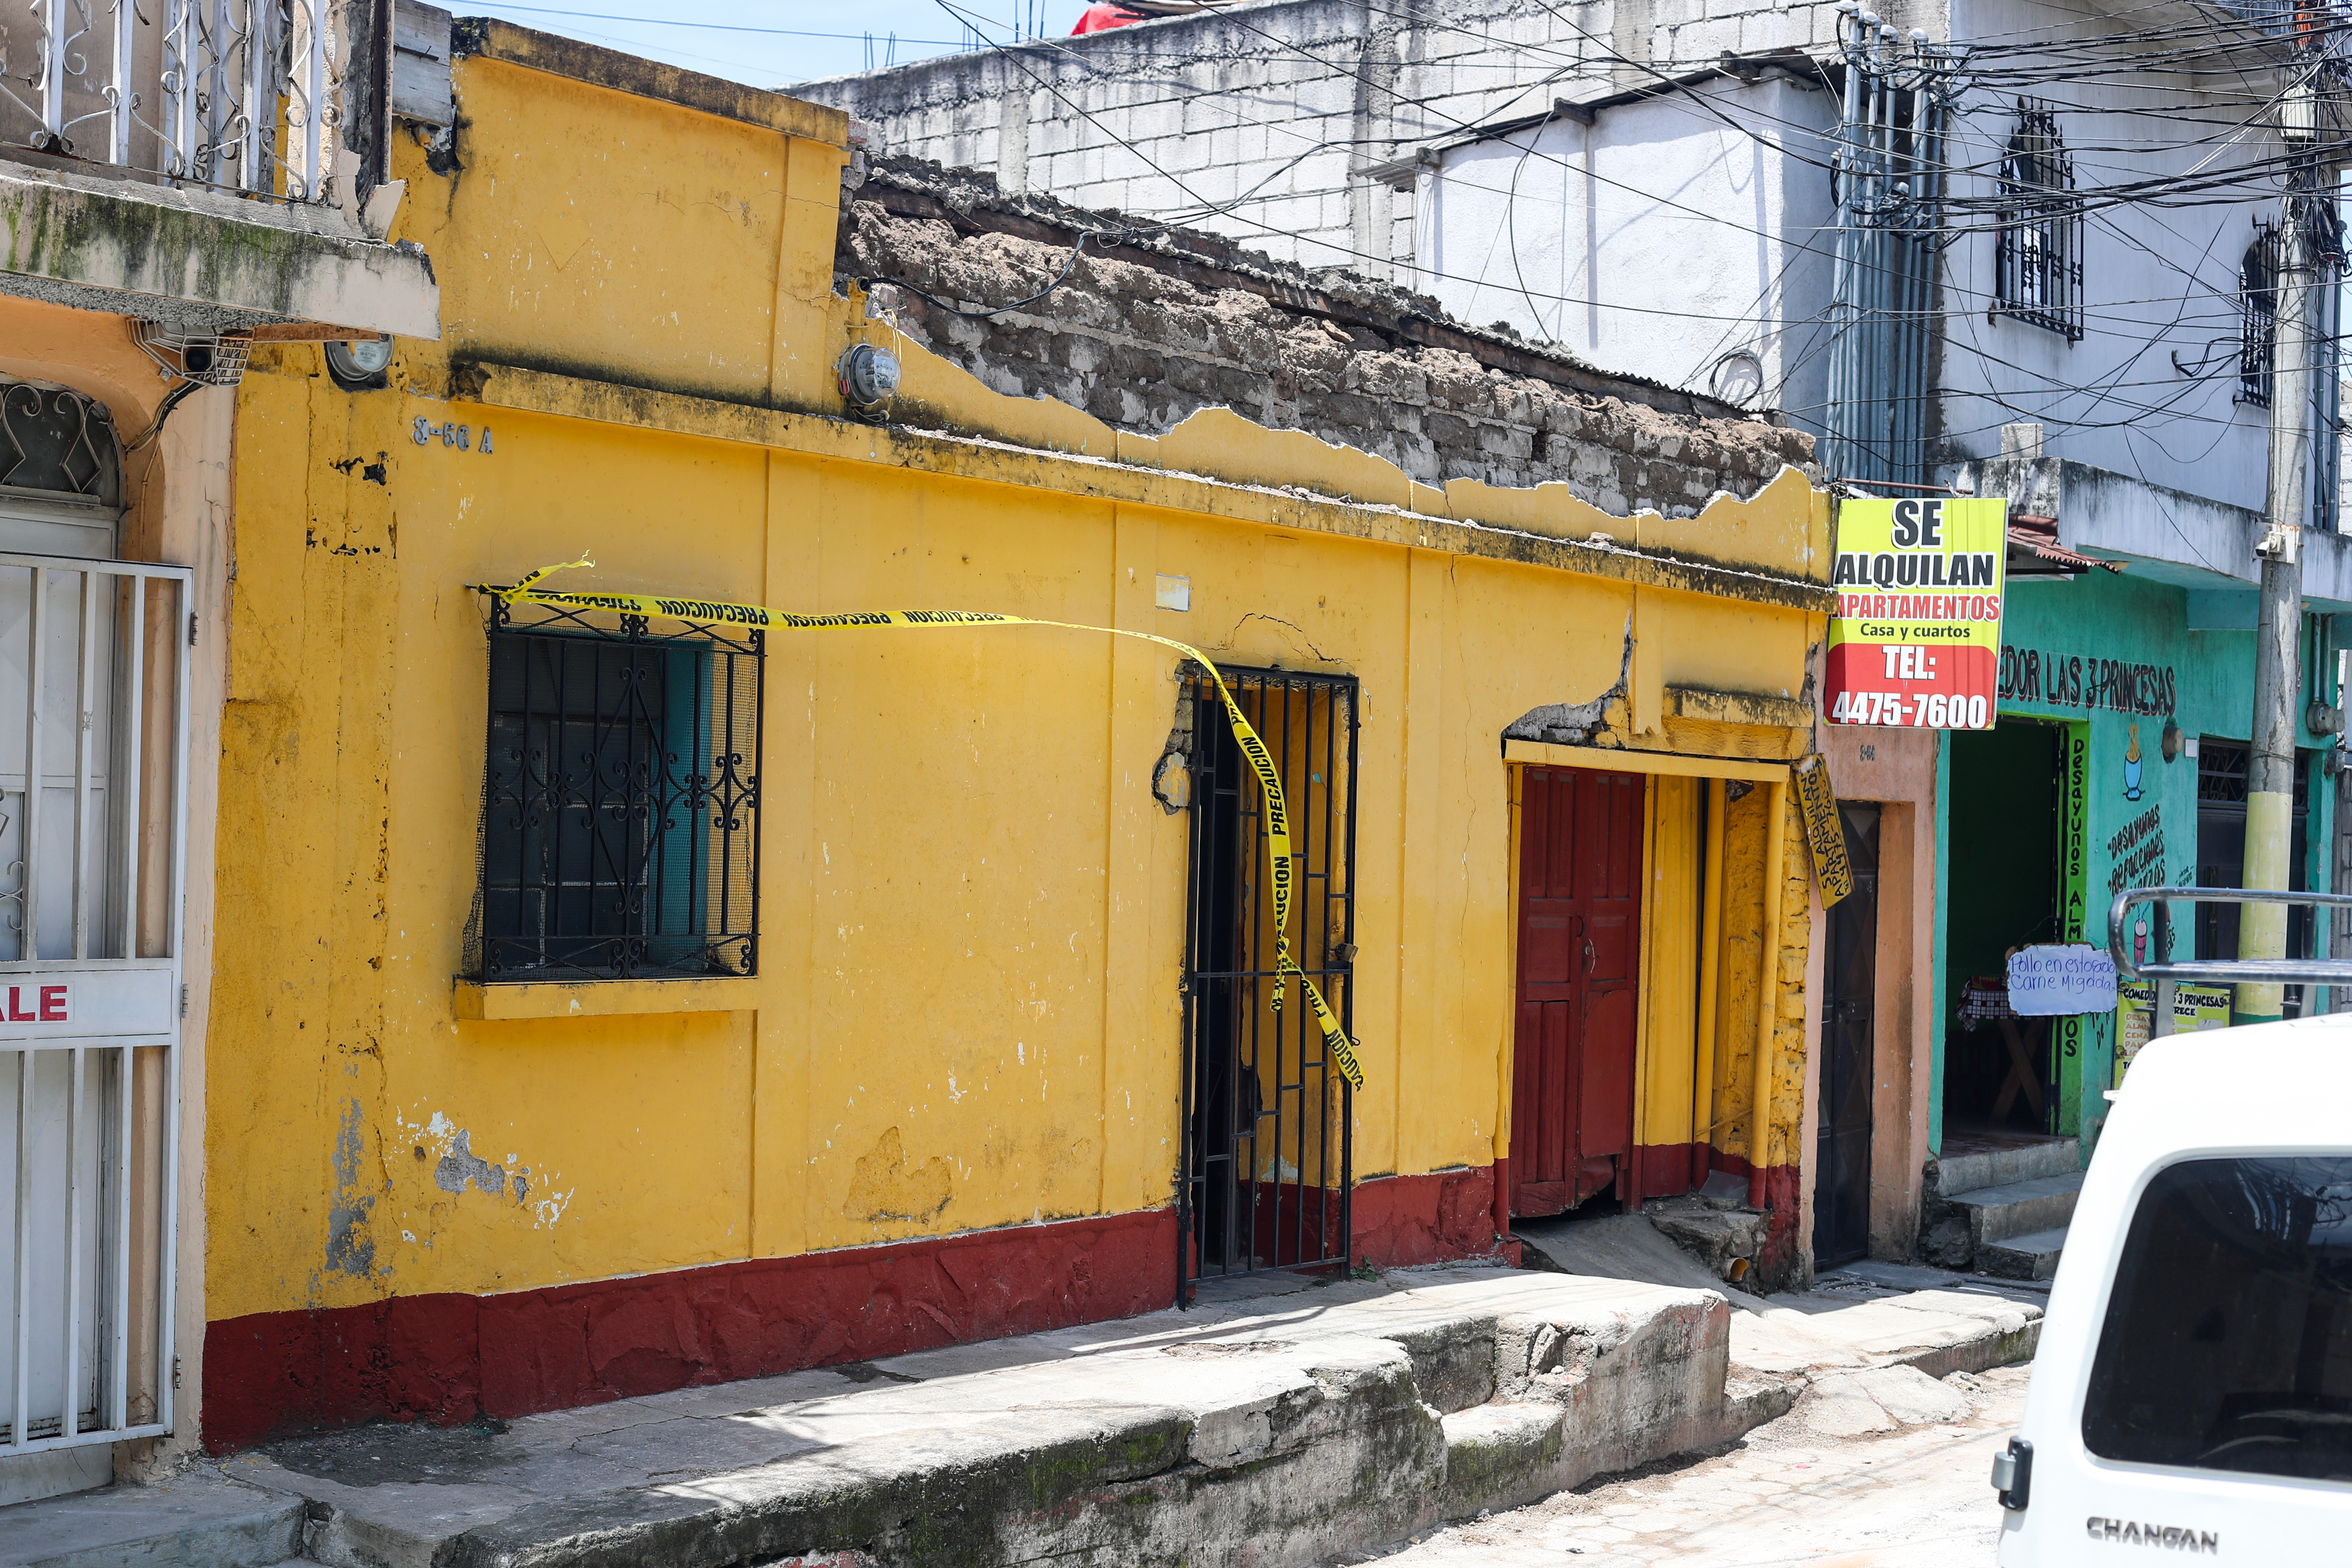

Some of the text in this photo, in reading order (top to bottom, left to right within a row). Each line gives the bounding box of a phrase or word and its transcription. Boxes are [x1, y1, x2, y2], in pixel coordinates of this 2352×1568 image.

[478, 426, 494, 454] A
[1893, 500, 1942, 547] SE
[1834, 554, 1995, 587] ALQUILAN
[655, 600, 769, 626] PRECAUCION
[781, 611, 892, 628] PRECAUCION
[1831, 594, 1999, 620] APARTAMENTOS
[1860, 623, 1970, 640] Casa y cuartos
[1882, 645, 1936, 680] TEL:
[2046, 652, 2082, 708] LAS
[2085, 658, 2098, 709] 3
[2099, 658, 2176, 717] PRINCESAS
[1832, 691, 1987, 729] 4475-7600
[1241, 735, 1287, 836] PRECAUCION
[1807, 764, 1845, 897] APARTAMENTO
[1819, 862, 1832, 890] SE
[2011, 951, 2115, 978] Pollo en estofado
[2011, 974, 2057, 991] Carne
[2177, 992, 2183, 1004] 3
[2184, 994, 2224, 1008] PRINCESAS
[2087, 1516, 2219, 1556] CHANGAN
